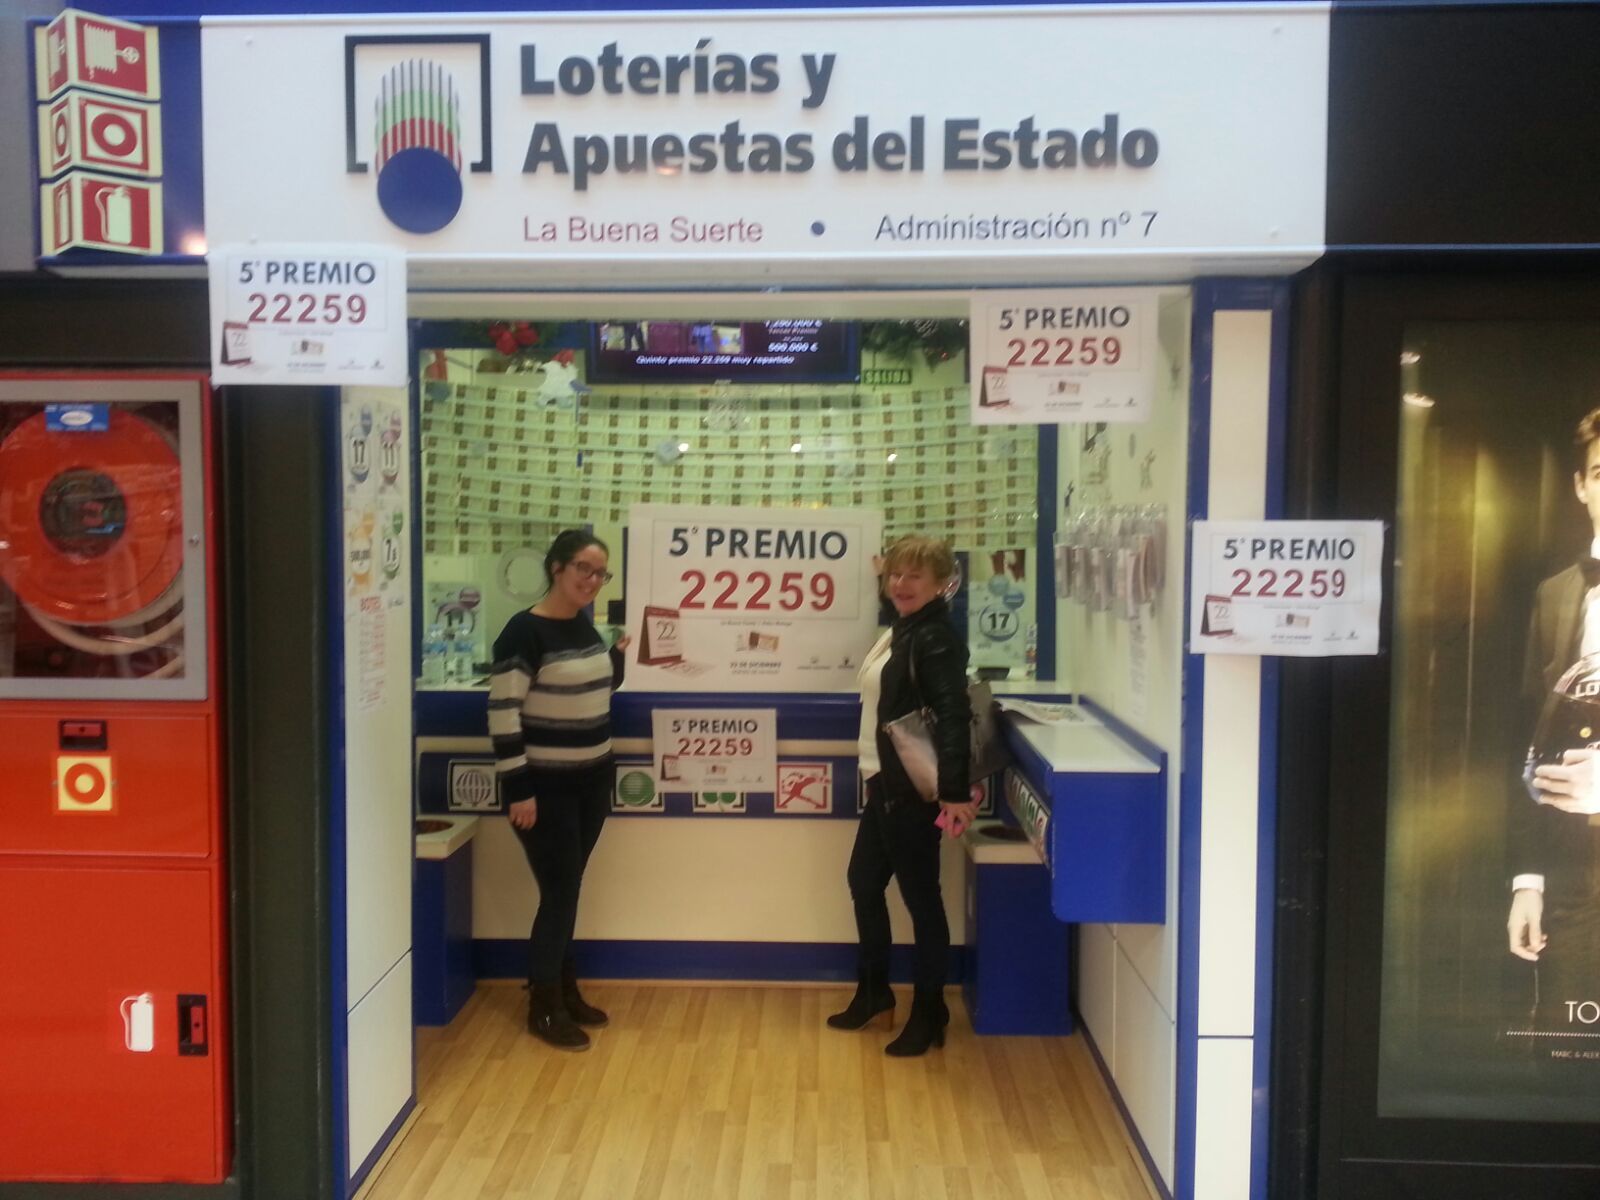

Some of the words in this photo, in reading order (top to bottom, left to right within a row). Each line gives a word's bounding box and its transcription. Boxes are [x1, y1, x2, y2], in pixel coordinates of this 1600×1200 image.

[520, 38, 780, 98] Loterías
[801, 53, 837, 110] y
[521, 120, 815, 193] Apuestas
[831, 115, 925, 174] del
[943, 113, 1159, 172] Estado
[524, 216, 557, 242] La
[568, 216, 659, 242] Buena
[670, 216, 763, 242] Suerte
[875, 211, 1089, 241] Administración
[1144, 211, 1158, 237] 7
[266, 260, 376, 286] PREMIO
[247, 293, 367, 325] 22259
[1024, 305, 1130, 330] PREMIO
[1006, 336, 1121, 366] 22259
[705, 527, 848, 561] PREMIO
[1250, 538, 1356, 561] PREMIO
[679, 569, 836, 612] 22259
[1231, 568, 1347, 599] 22259
[988, 612, 1010, 629] 17
[688, 718, 759, 735] PREMIO
[677, 737, 753, 757] 22259
